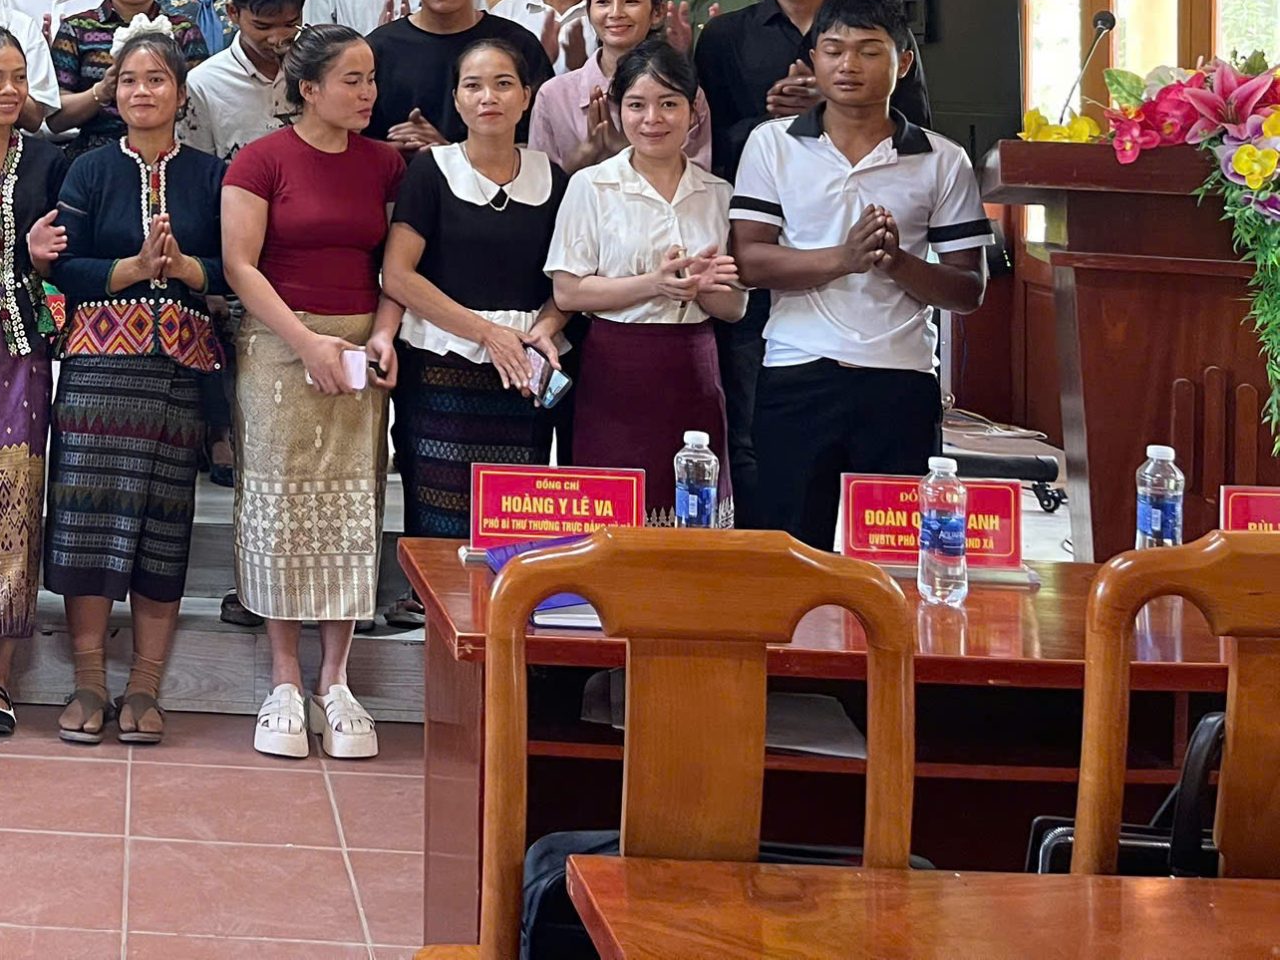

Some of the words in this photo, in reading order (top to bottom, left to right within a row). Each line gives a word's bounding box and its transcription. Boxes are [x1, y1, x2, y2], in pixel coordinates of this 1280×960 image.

[501, 493, 555, 515] HOÀNG
[558, 497, 569, 515] Y
[572, 496, 591, 516] LÊ
[593, 499, 614, 517] VA
[864, 507, 908, 527] ĐOÀN
